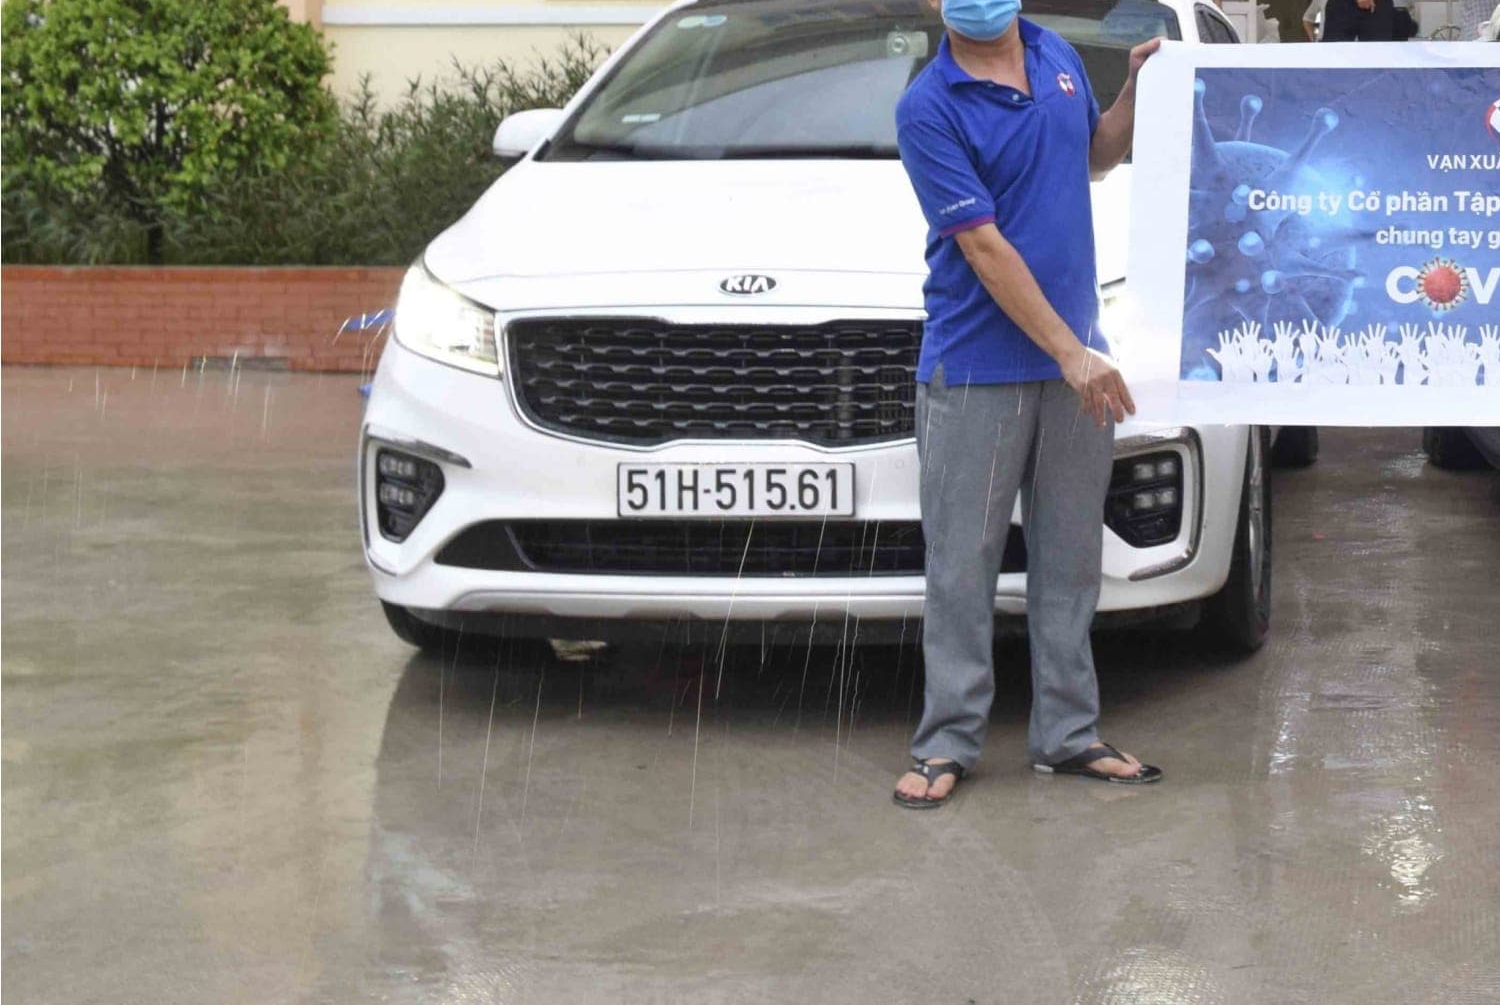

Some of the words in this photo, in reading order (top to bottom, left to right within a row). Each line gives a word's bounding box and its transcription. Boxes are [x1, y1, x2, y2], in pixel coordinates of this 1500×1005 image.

[1426, 154, 1470, 173] VẠN
[1248, 189, 1312, 215] Công
[1319, 191, 1341, 215] ty
[1348, 188, 1381, 212] Cổ
[1386, 189, 1447, 217] phần
[1454, 190, 1500, 217] Tập
[1375, 226, 1443, 249] chung
[1448, 227, 1483, 250] tay
[723, 275, 772, 293] KIA
[627, 468, 838, 511] 51H-515.61
